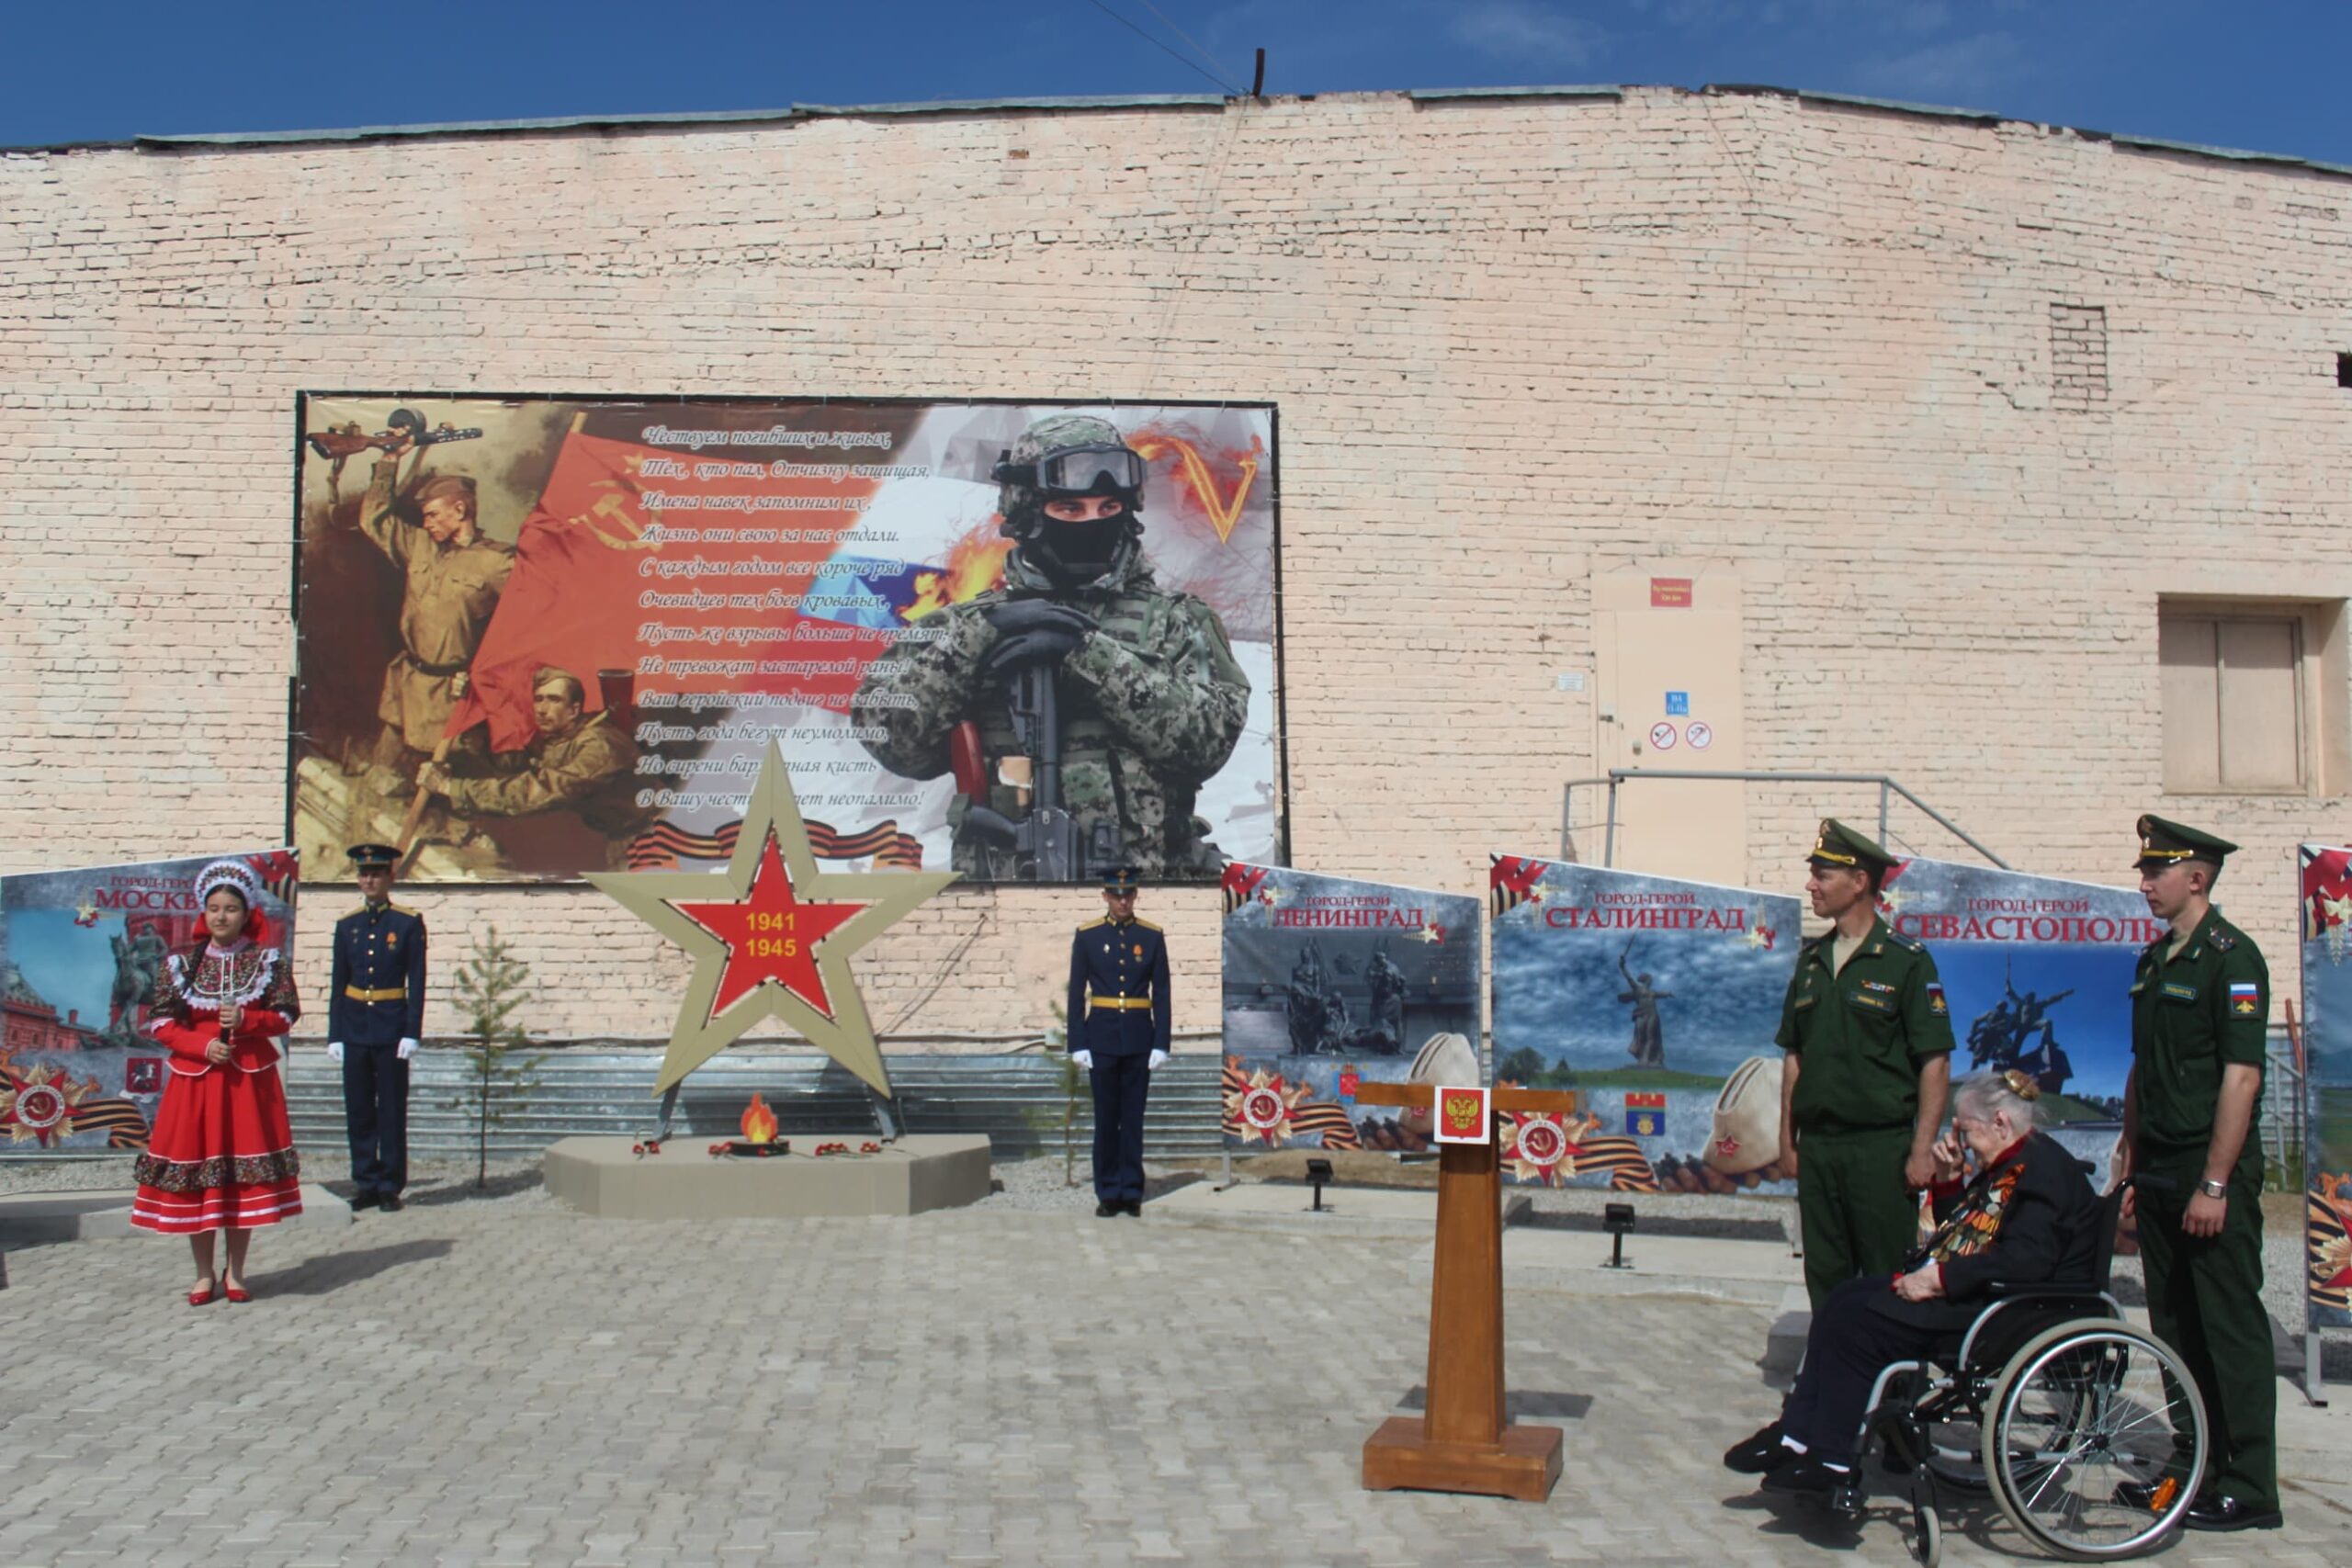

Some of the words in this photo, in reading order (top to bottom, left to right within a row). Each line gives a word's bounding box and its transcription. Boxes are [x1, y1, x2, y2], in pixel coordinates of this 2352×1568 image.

[643, 425, 728, 450] Чествуем
[731, 423, 813, 448] погибших
[815, 432, 826, 445] и
[829, 431, 890, 449] живых,
[695, 462, 729, 478] кто
[733, 464, 766, 479] пал,
[771, 461, 848, 481] Отчизну
[850, 465, 929, 481] защищая,
[639, 493, 699, 510] Имена
[704, 496, 751, 510] навек
[752, 496, 839, 510] запомним
[639, 525, 698, 543] Жизнь
[703, 529, 733, 541] они
[737, 529, 776, 542] свою
[781, 530, 798, 542] за
[805, 530, 831, 542] нас
[835, 526, 899, 543] отдали.
[639, 559, 655, 576] С
[657, 558, 728, 578] каждым
[732, 559, 781, 575] годом
[786, 562, 810, 575] все
[815, 562, 868, 578] короче
[872, 560, 905, 580] ряд
[639, 591, 724, 611] Очевидцев
[729, 595, 762, 608] тех
[765, 591, 799, 607] боев
[803, 595, 889, 612] кровавых,
[638, 625, 695, 646] Пусть
[699, 627, 720, 641] же
[725, 628, 790, 646] взрывы
[794, 621, 853, 641] больше
[857, 628, 877, 640] не
[638, 658, 662, 674] Не
[667, 660, 753, 678] тревожат
[758, 658, 855, 678] застарелой
[855, 658, 910, 678] раны!
[639, 691, 676, 707] Ваш
[679, 692, 765, 712] геройский
[768, 691, 823, 709] подвиг
[828, 694, 847, 706] не
[851, 689, 919, 710] забыть,
[636, 723, 694, 745] Пусть
[697, 724, 733, 740] года
[791, 727, 888, 744] неумолимо,
[636, 756, 663, 773] Но
[666, 760, 726, 779] сирени
[823, 760, 876, 777] кисть
[636, 789, 655, 807] В
[656, 789, 705, 808] Вашу
[828, 790, 924, 807] неопалимо!
[110, 875, 195, 887] ГОРОД-ГЕРО
[95, 888, 198, 910] МОСКВ
[1305, 894, 1390, 908] ГОРОД-ГЕРОЙ
[1594, 892, 1695, 906] ГОРОД-ГЕРОЙ
[1968, 897, 2089, 913] ГОРОД-ГЕРОЙ
[746, 913, 796, 931] 1941
[1273, 908, 1424, 930] ЛЕНИНГРАД
[1545, 908, 1746, 931] СТАЛИНГРАД
[1894, 913, 2164, 942] СЕВАСТОПОЛЬ
[746, 939, 797, 957] 1945
